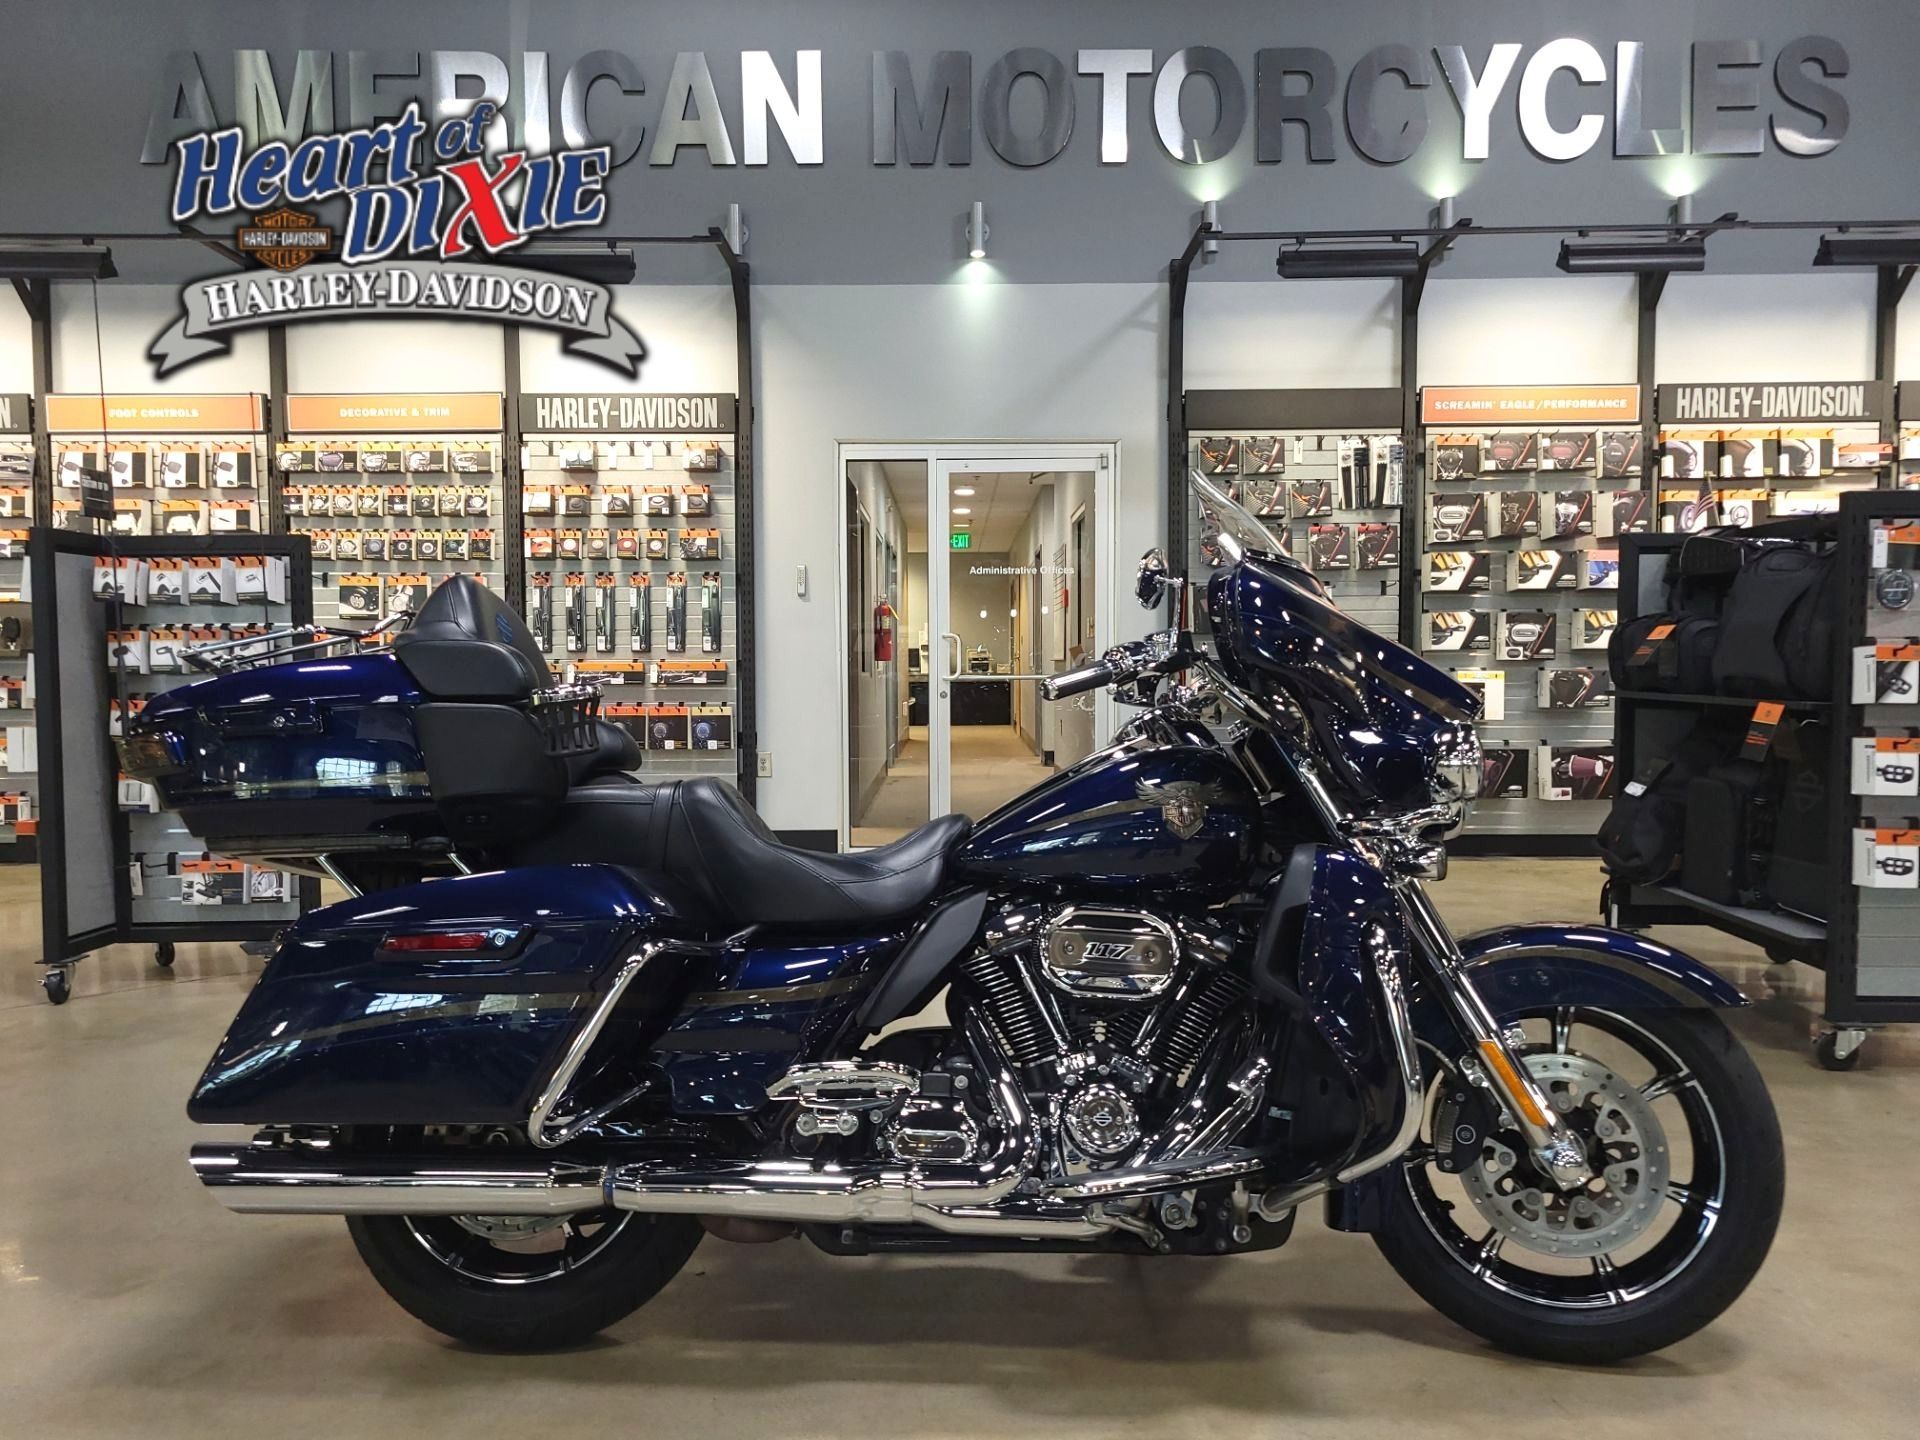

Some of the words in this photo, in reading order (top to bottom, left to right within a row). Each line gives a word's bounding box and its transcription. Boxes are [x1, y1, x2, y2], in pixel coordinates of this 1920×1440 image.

[140, 49, 824, 167] AMERICAN
[872, 36, 1850, 168] MOTORCYCLES
[1676, 385, 1865, 419] HARLEY-DAVIDSON
[109, 408, 138, 418] FOOT
[141, 408, 199, 418] CONTROLS
[339, 407, 408, 418] DECORATIVE
[412, 407, 420, 417] &
[424, 407, 450, 417] TRIM
[536, 397, 718, 429] HARLEY-DAVIDSON
[953, 534, 969, 548] EXIT
[969, 565, 1038, 575] Administrative
[1039, 565, 1075, 575] Offices
[1083, 942, 1135, 959] 117
